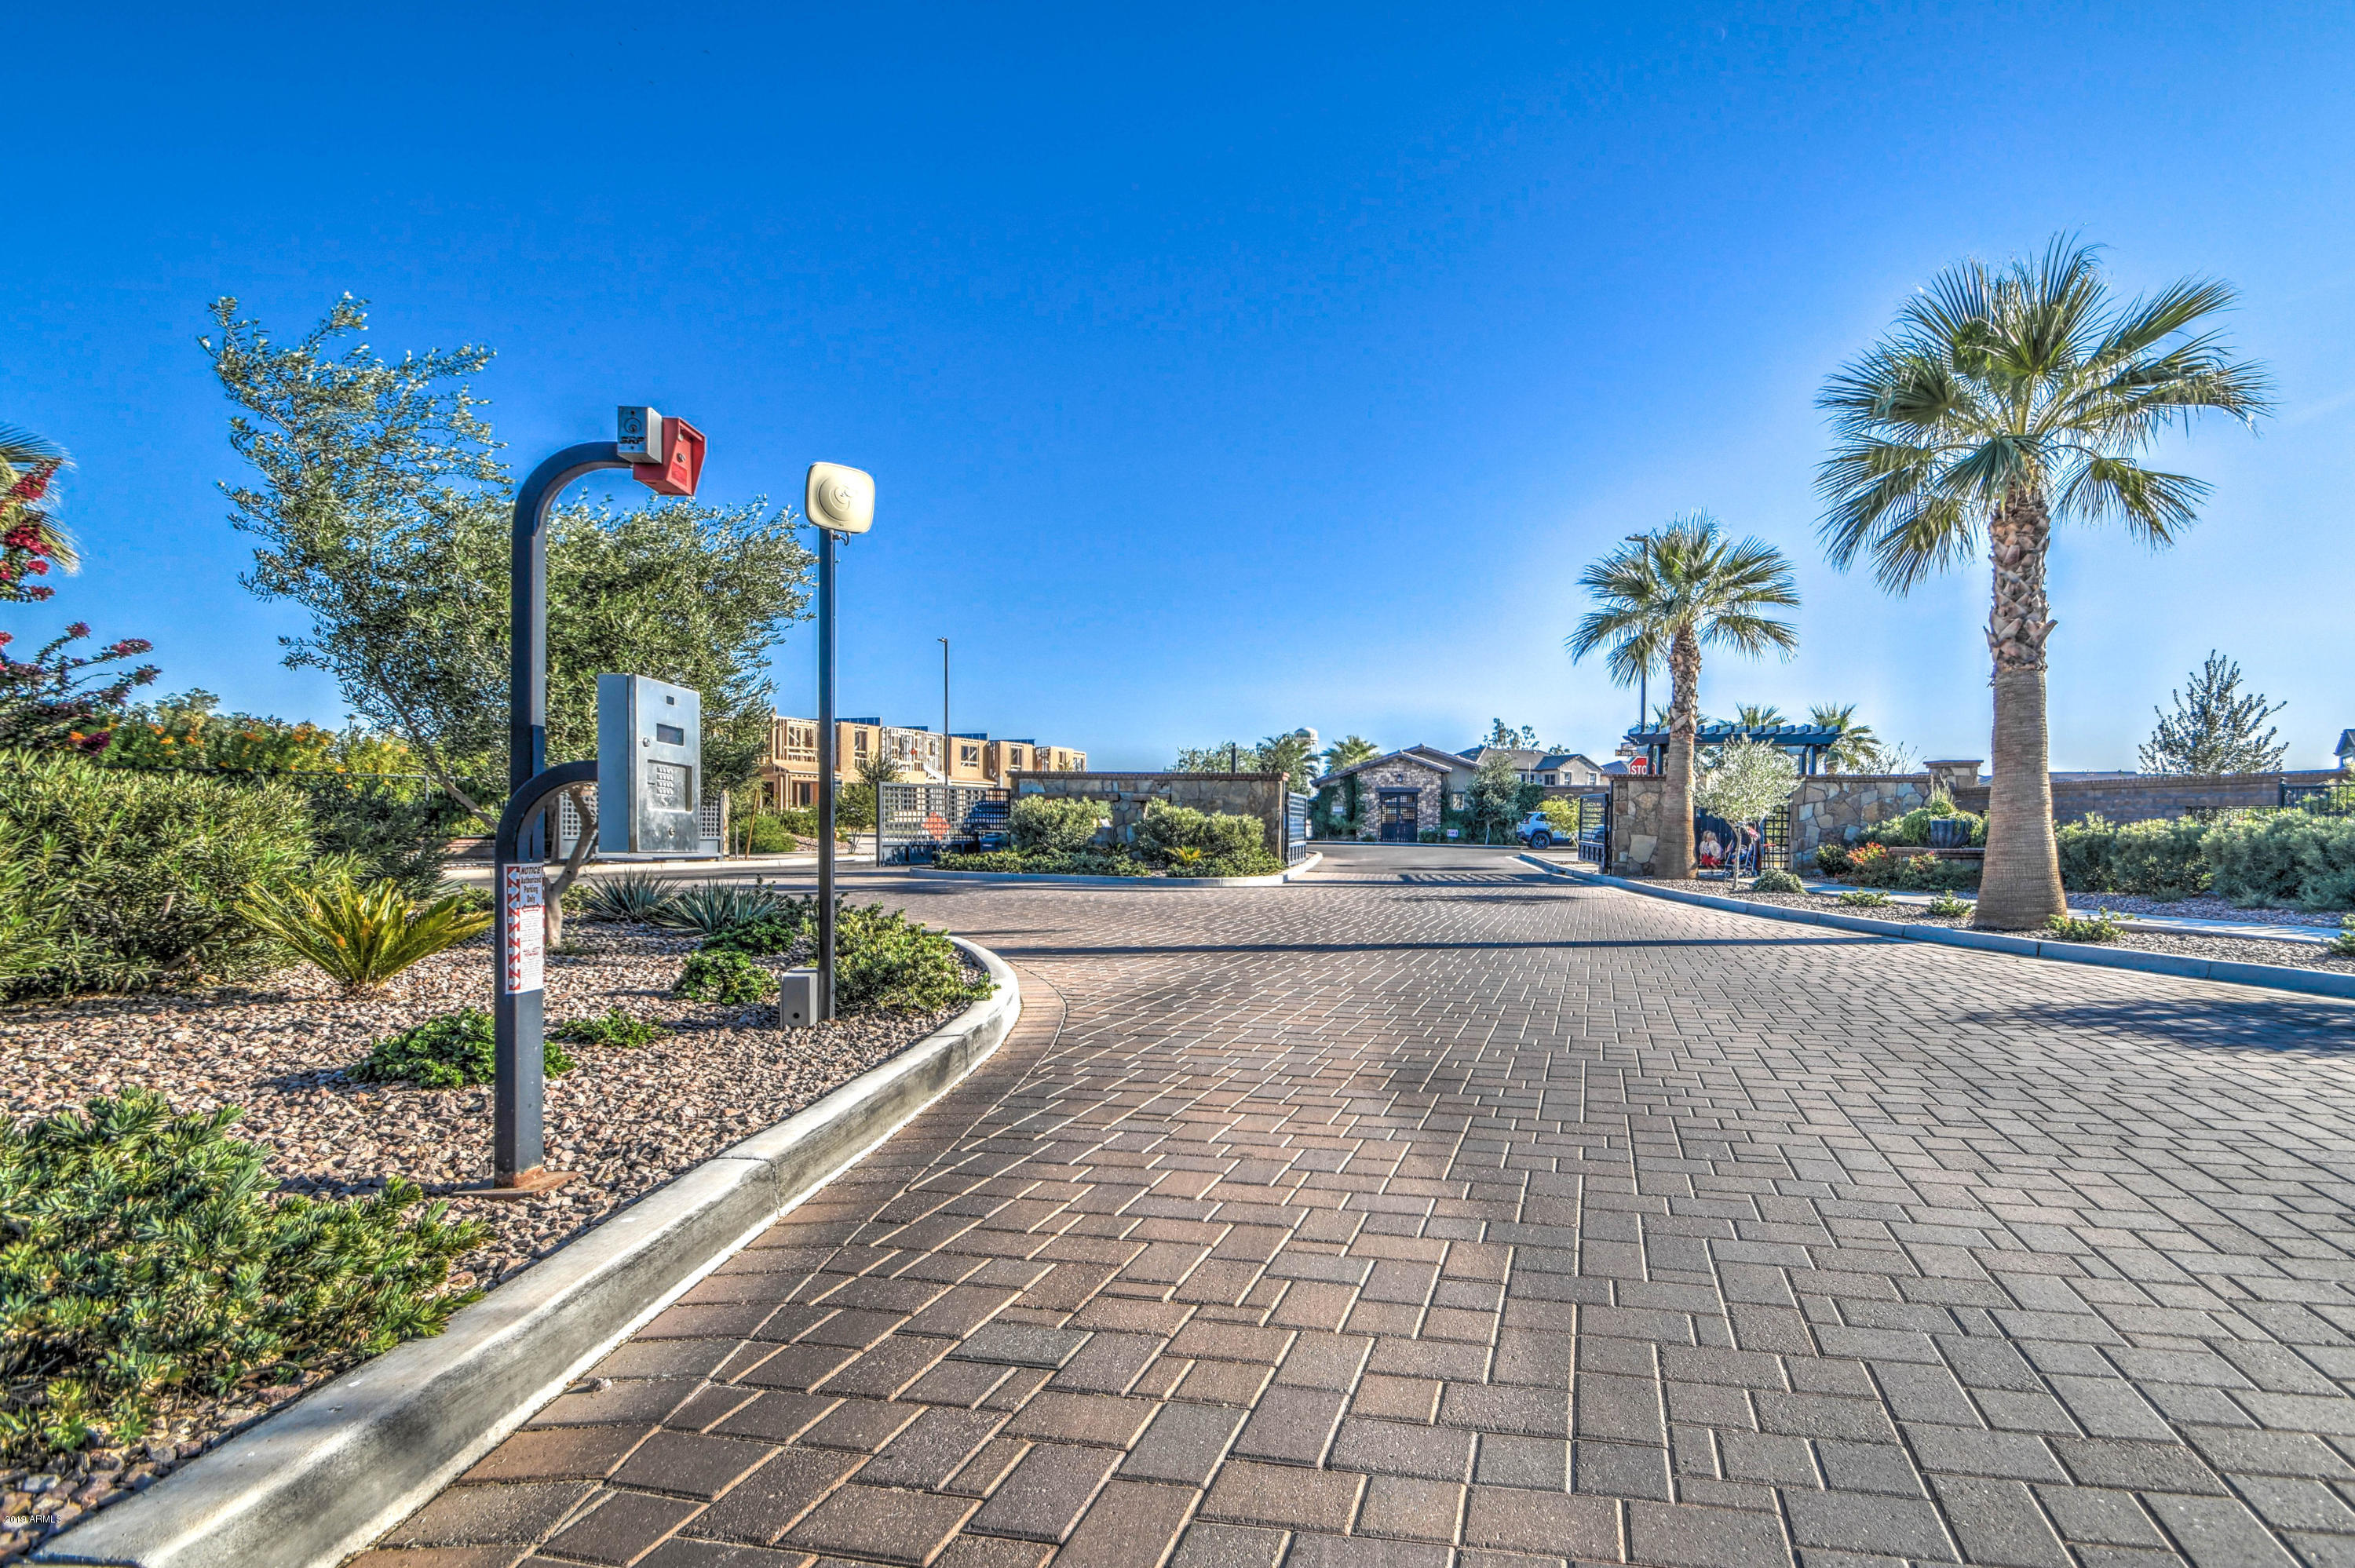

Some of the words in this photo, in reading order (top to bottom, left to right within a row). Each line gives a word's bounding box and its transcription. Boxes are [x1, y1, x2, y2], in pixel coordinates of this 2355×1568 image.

[1630, 764, 1647, 775] STO
[520, 866, 542, 875] NOTICE
[520, 876, 542, 884] Authorized
[524, 885, 539, 895] Parking
[527, 894, 535, 904] Only
